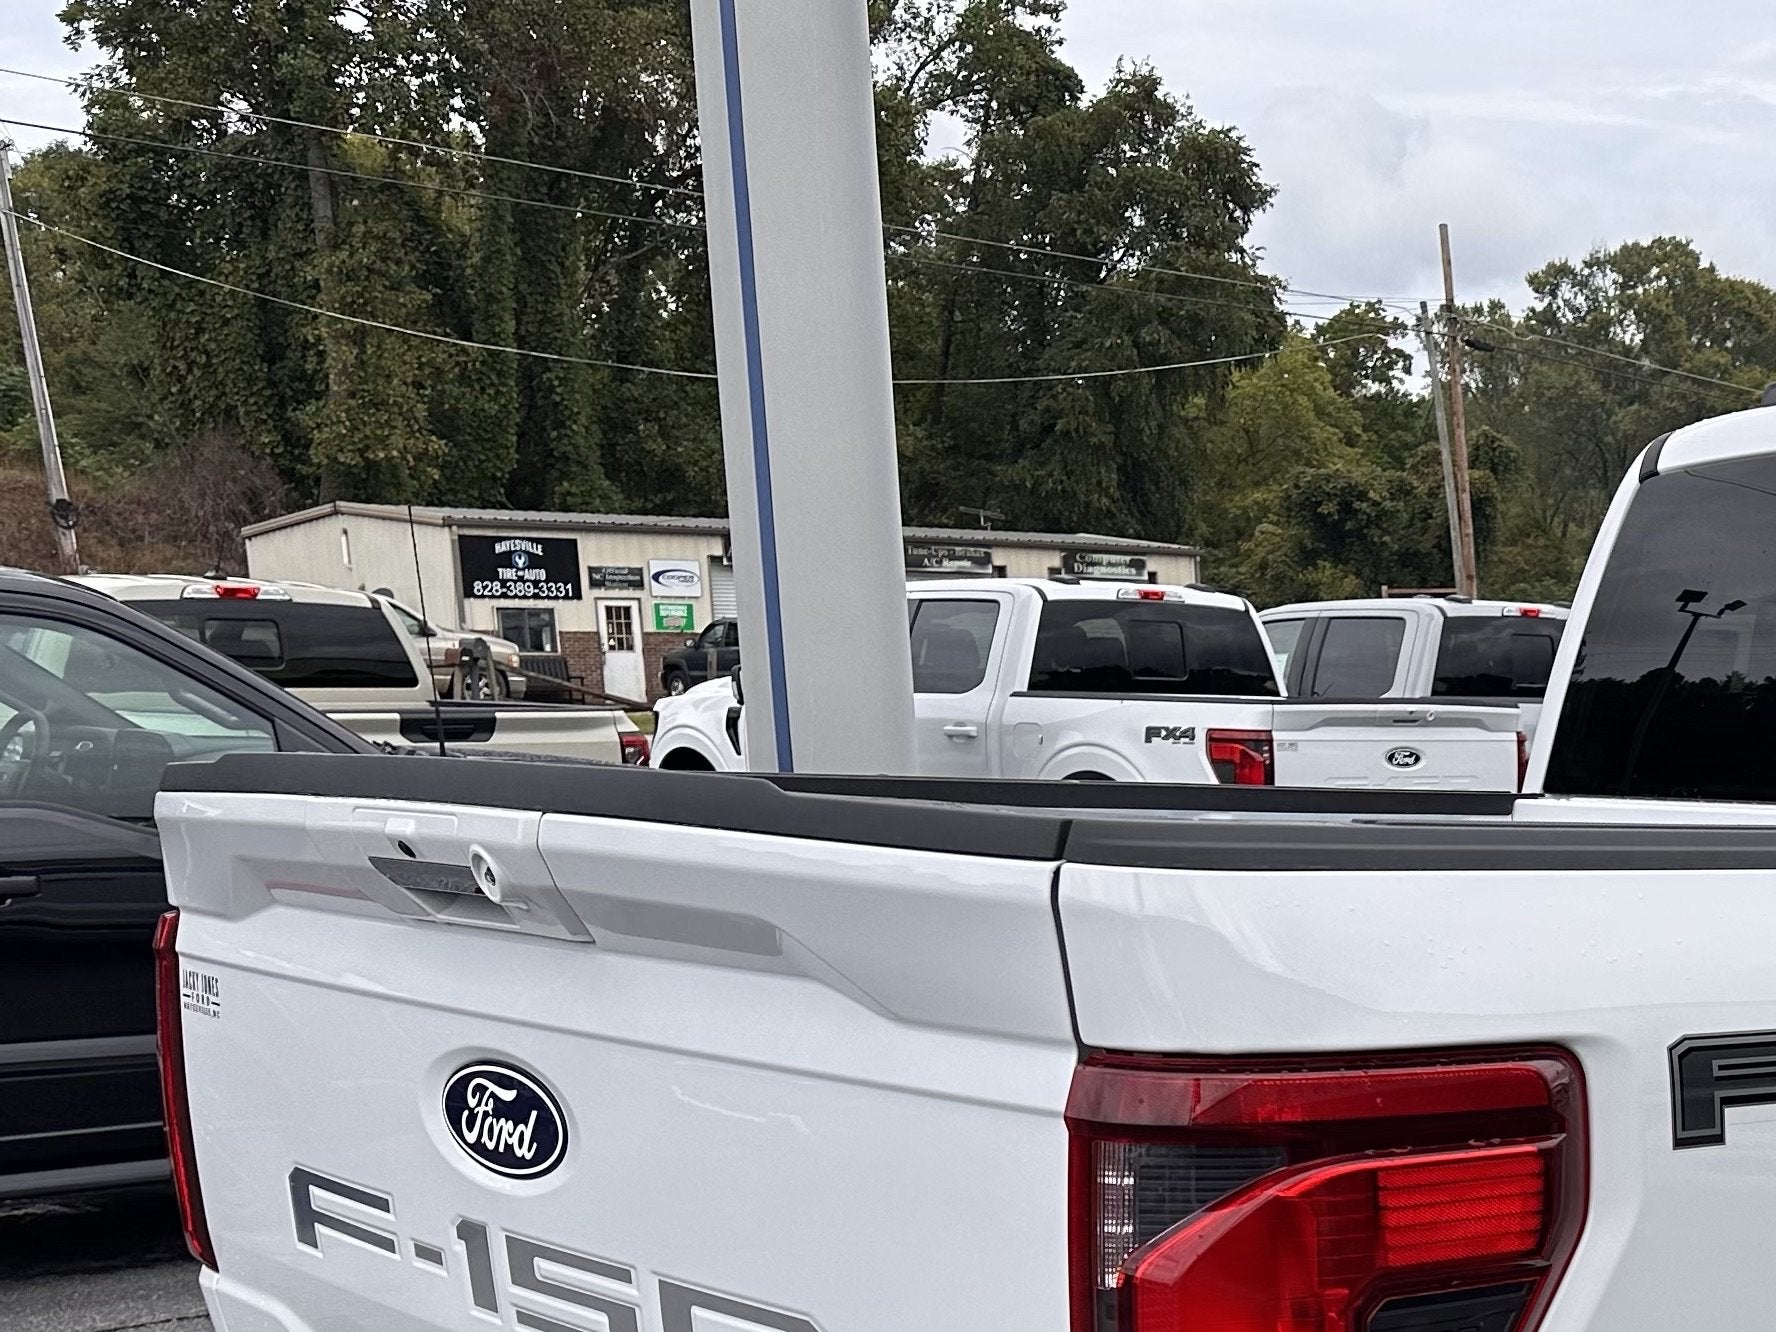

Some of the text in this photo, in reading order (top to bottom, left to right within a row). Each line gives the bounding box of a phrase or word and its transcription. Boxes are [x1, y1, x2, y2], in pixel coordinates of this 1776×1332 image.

[495, 540, 543, 555] HAYESVILLE
[1076, 552, 1131, 565] Computer
[497, 568, 517, 580] TIRE
[524, 569, 546, 581] AUTO
[1074, 563, 1137, 575] Diagnostics
[473, 581, 573, 598] 828-389-3331
[1144, 726, 1196, 744] FX4
[1392, 750, 1416, 765] Ford
[461, 1076, 539, 1161] Ford
